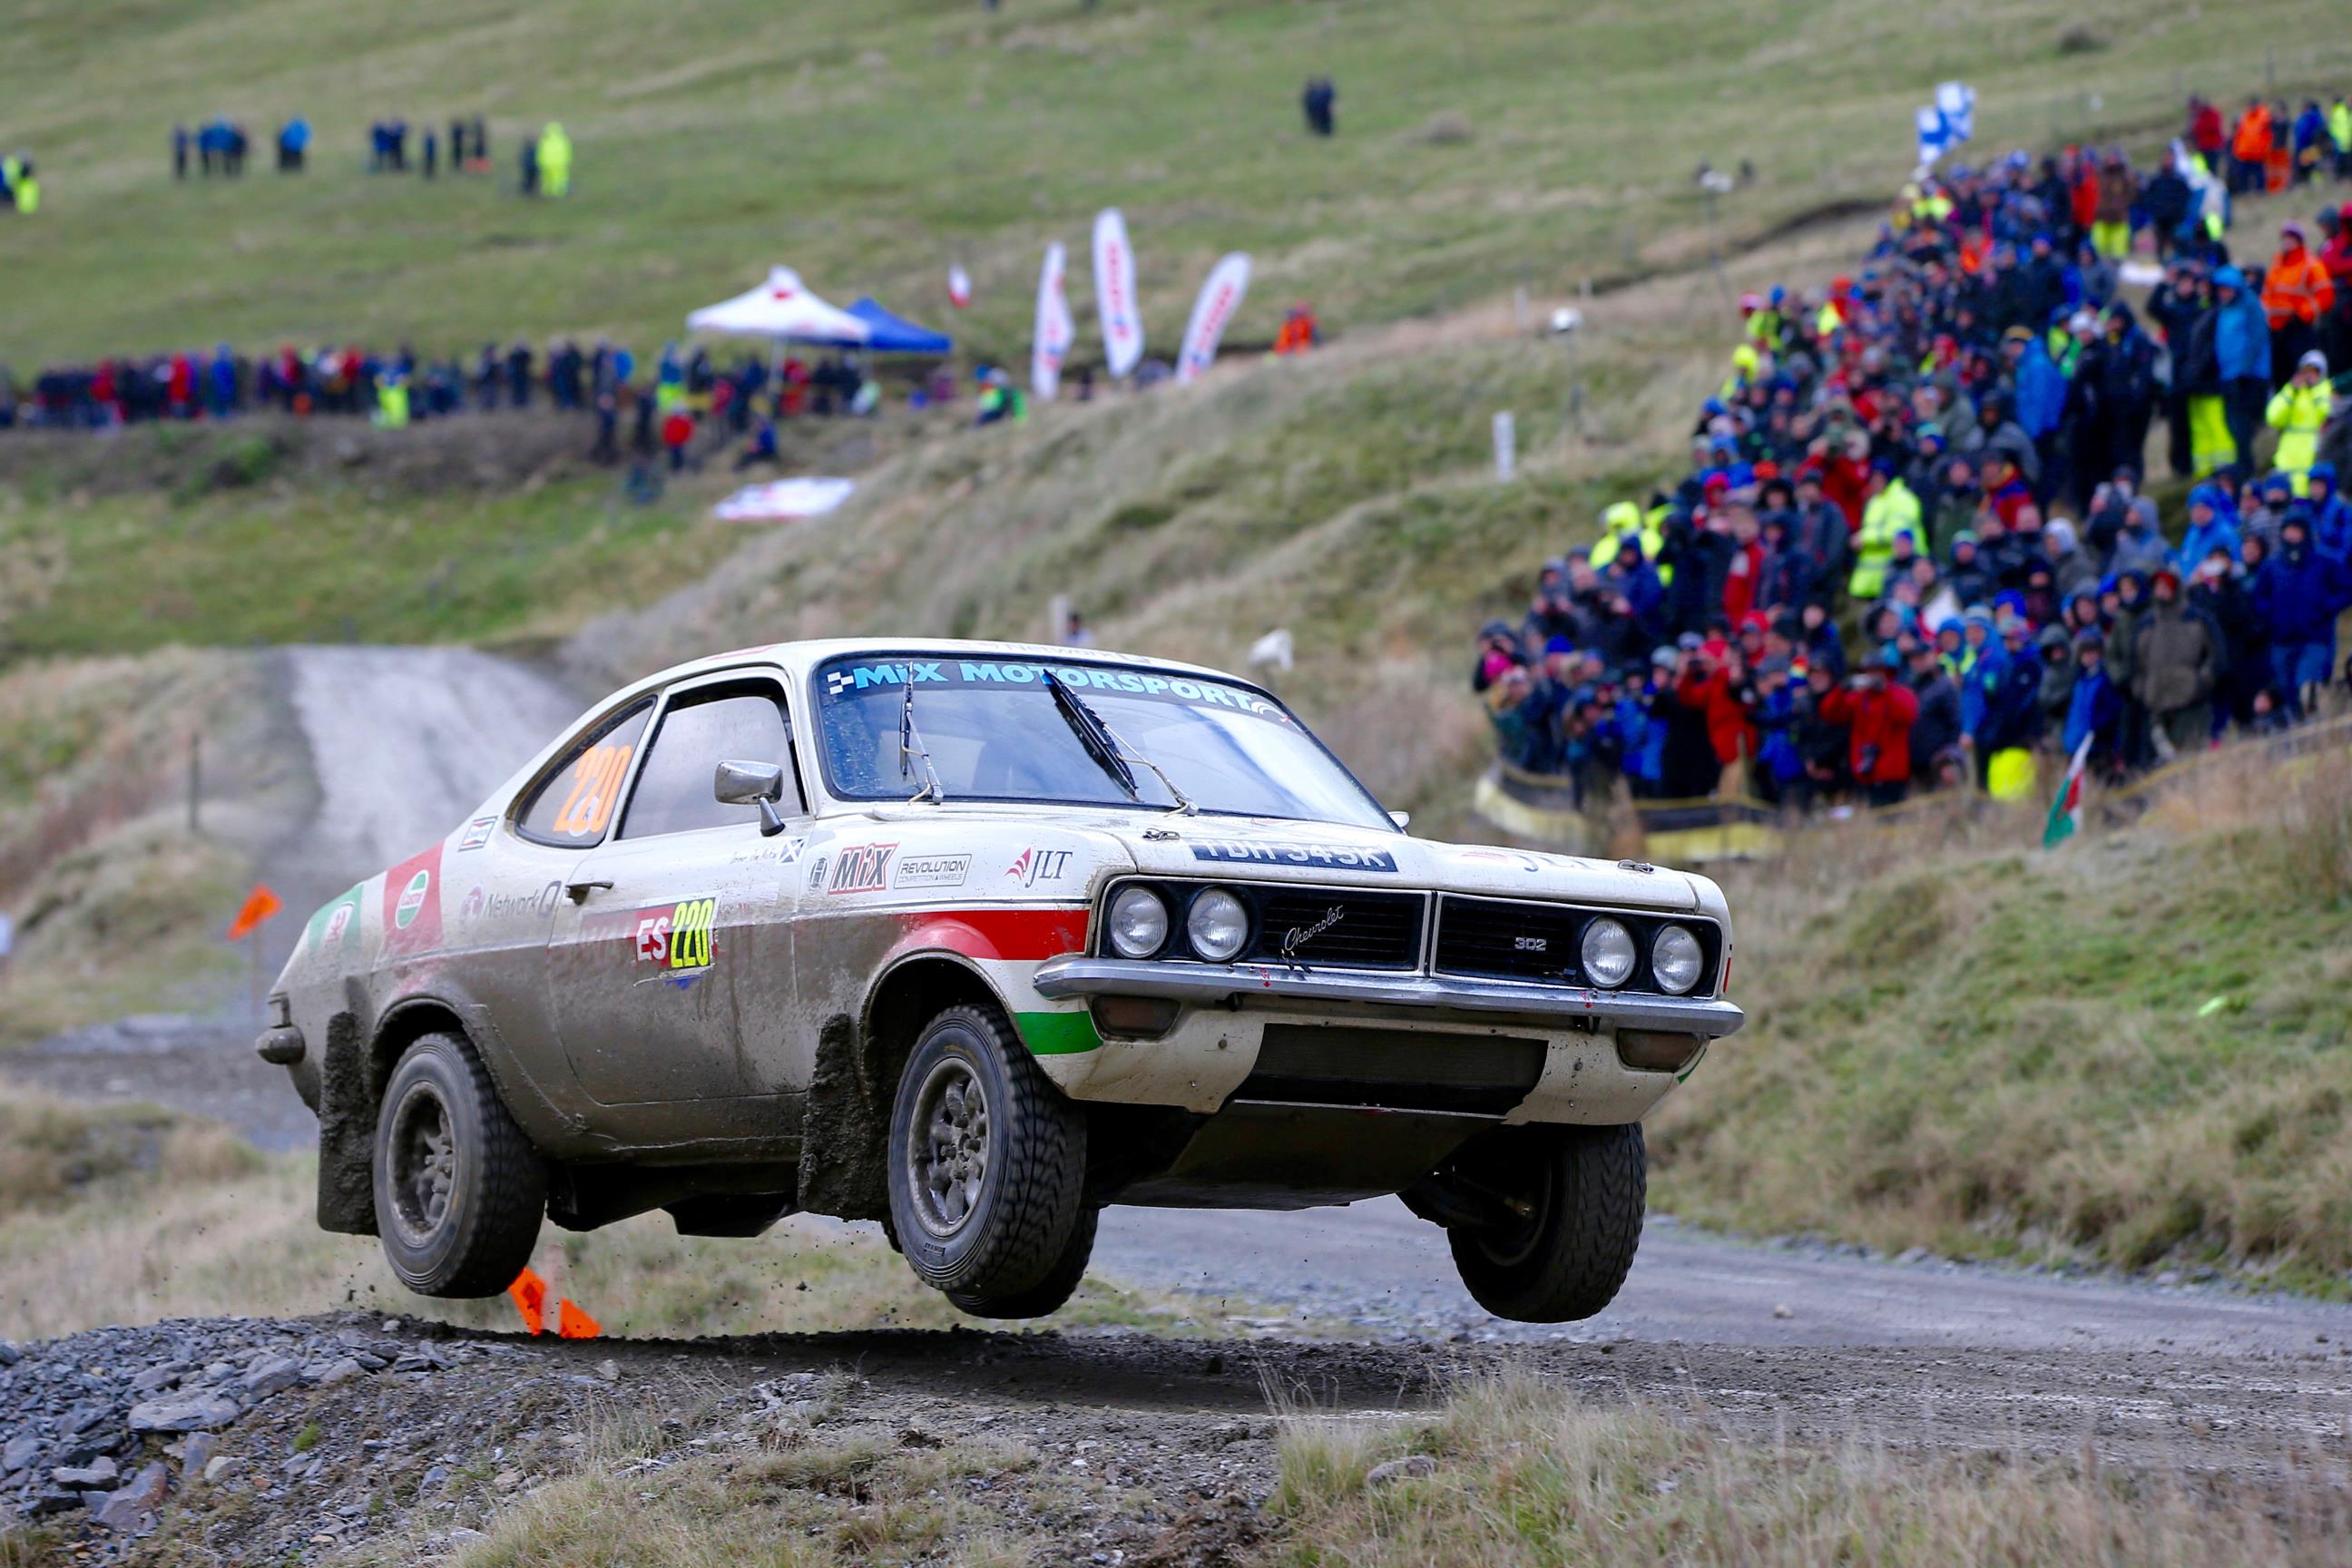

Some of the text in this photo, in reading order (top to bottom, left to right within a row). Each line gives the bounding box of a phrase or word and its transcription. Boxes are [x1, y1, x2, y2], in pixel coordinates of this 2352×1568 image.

[958, 662, 1253, 712] MOTORSPORT
[552, 744, 633, 833] 220
[900, 860, 967, 875] REVOLUTION
[1024, 850, 1073, 888] JLT
[670, 899, 714, 968] 220
[1284, 905, 1344, 951] Chevrolet
[1514, 936, 1547, 952] 302
